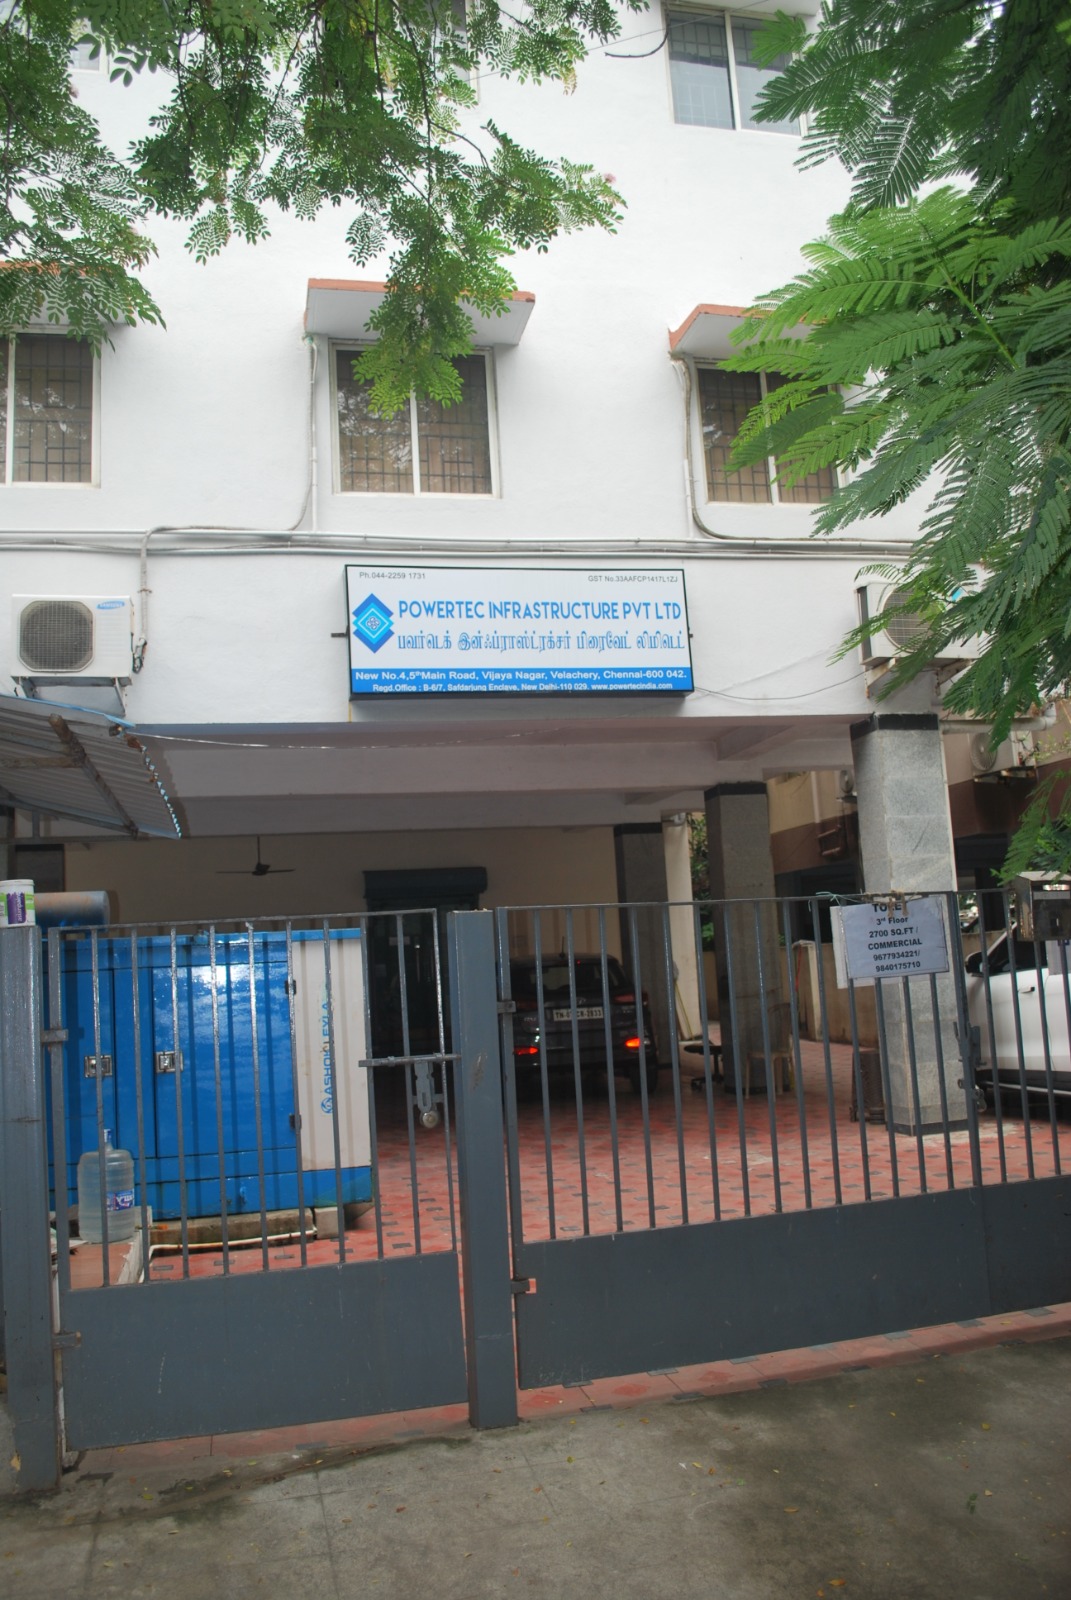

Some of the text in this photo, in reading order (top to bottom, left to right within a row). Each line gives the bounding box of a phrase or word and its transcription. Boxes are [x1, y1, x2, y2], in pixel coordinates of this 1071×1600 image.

[398, 600, 681, 619] POWERTEC INFRASTRUCTURE PVT LTD
[577, 630, 631, 652] பிரைவேட்
[636, 630, 684, 648] லிமிடெட்
[356, 672, 378, 680] New
[449, 672, 478, 680] Road,
[481, 672, 512, 681] Vijaya
[515, 672, 548, 680] Nagar,
[550, 671, 600, 680] Velachery,
[603, 670, 664, 678] Chennai-600
[666, 670, 687, 678] 042.
[372, 684, 417, 692] Regd.Office
[869, 929, 888, 938] 2700
[891, 927, 914, 936] SQ.FT
[868, 938, 922, 950] COMMERCIAL
[876, 962, 921, 972] 9840175710
